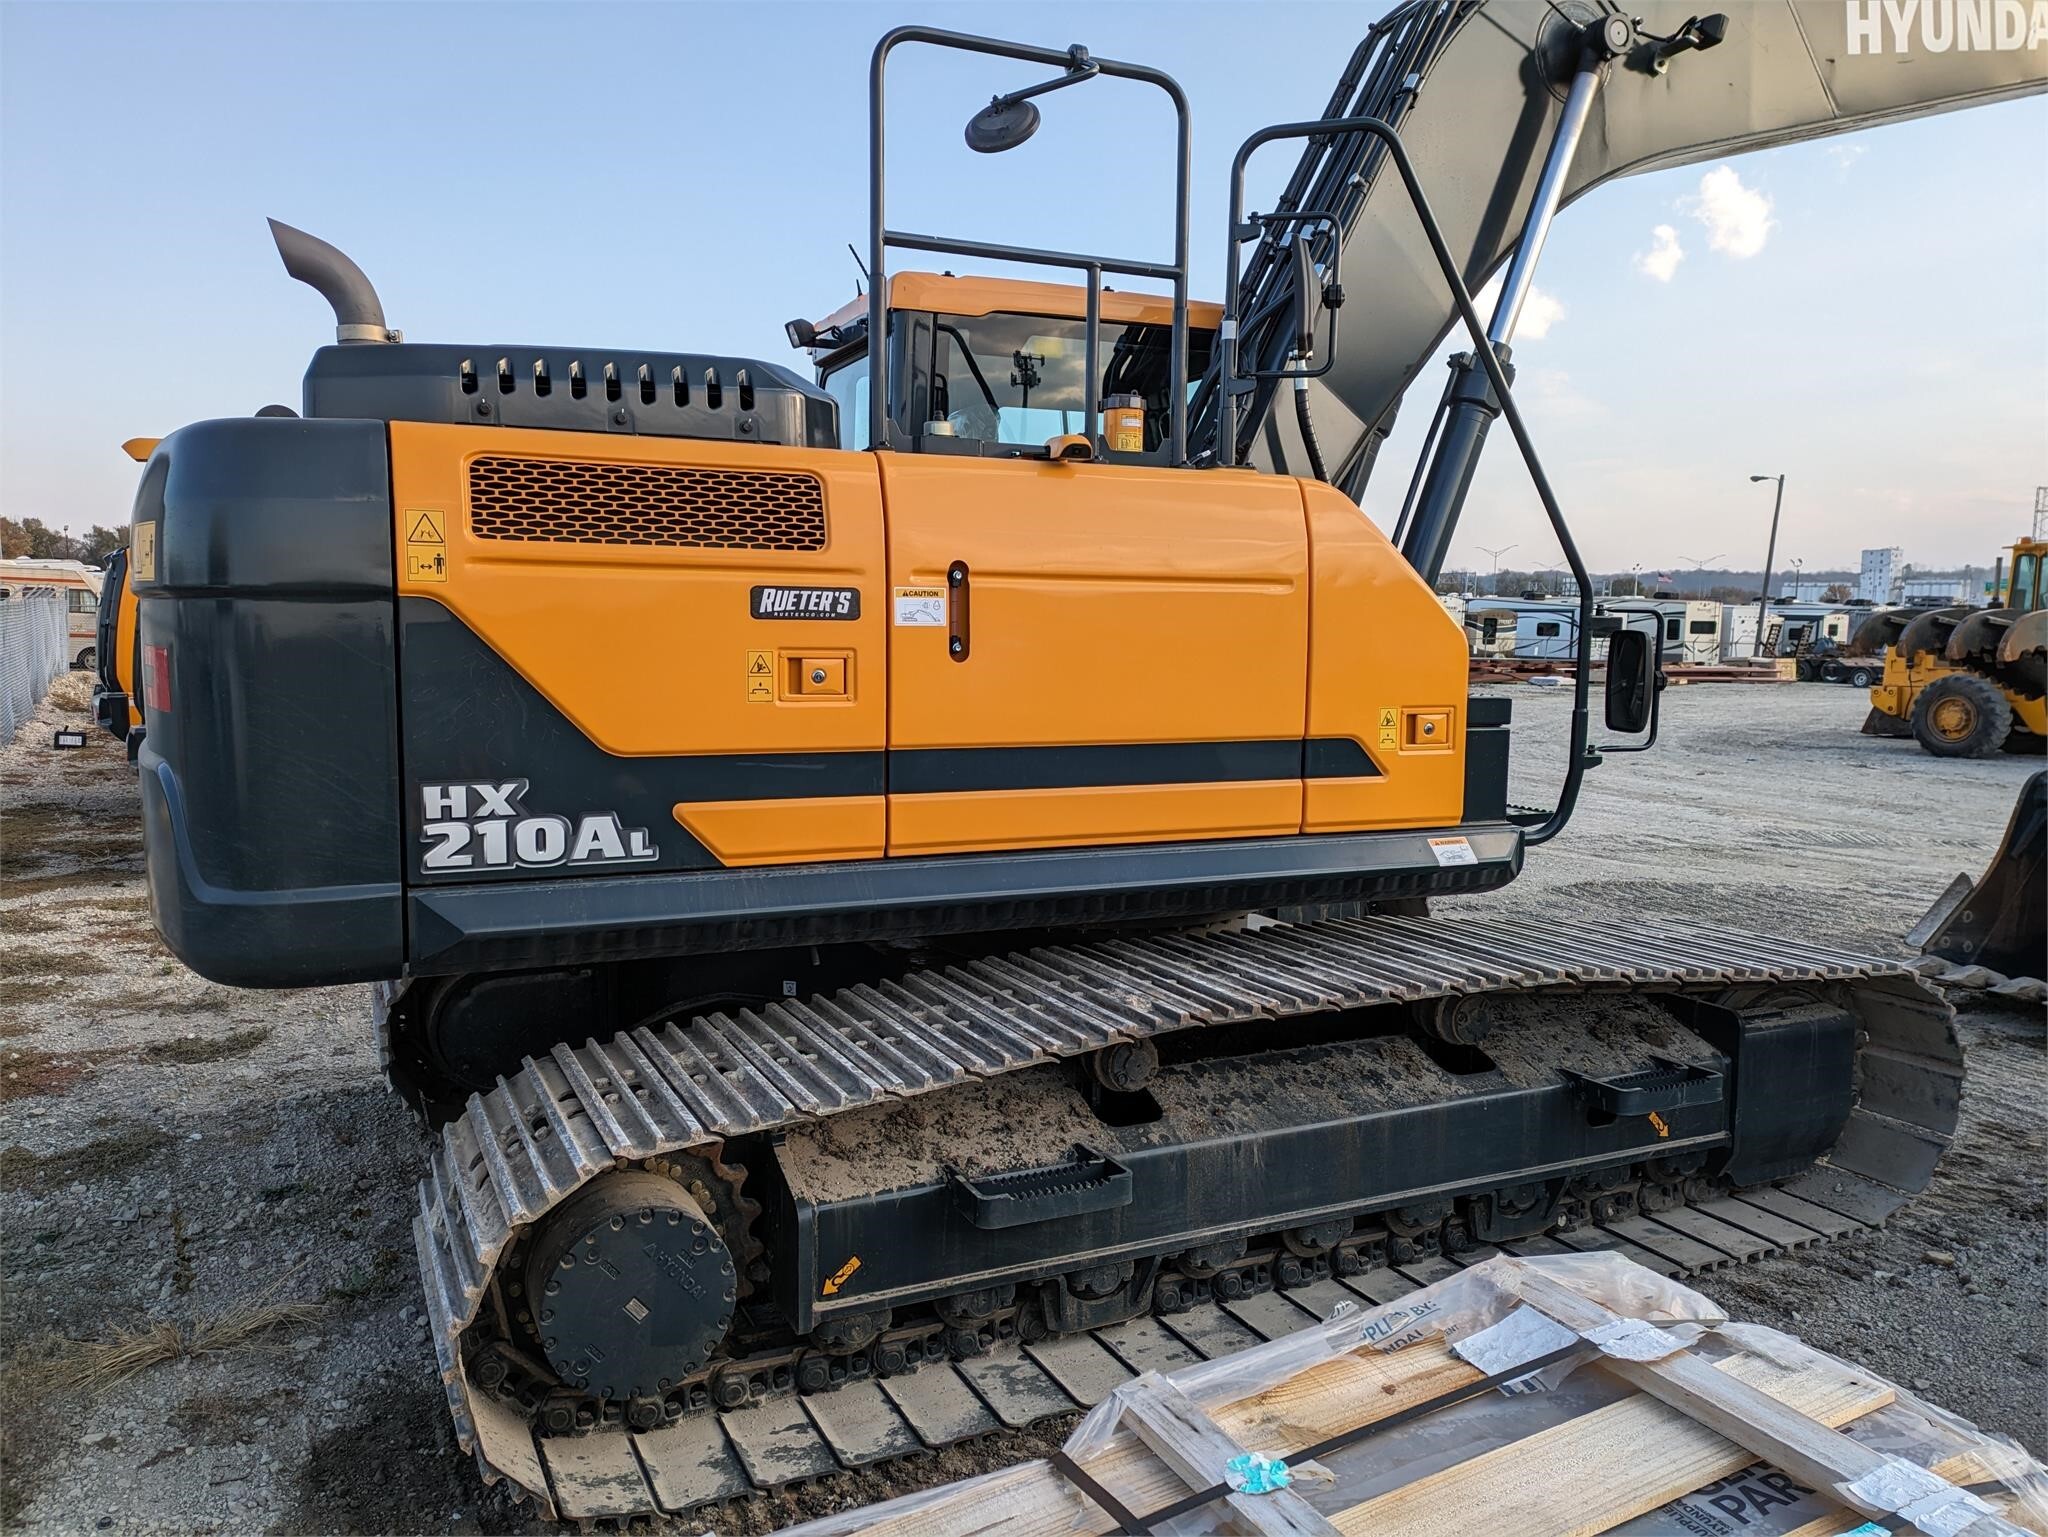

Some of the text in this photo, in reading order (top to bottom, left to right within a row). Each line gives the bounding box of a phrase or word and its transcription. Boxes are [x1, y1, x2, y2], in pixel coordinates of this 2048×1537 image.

[759, 588, 852, 614] RUETER'S
[423, 783, 519, 819] HX
[1409, 1300, 1437, 1316] BY:
[1662, 1505, 1713, 1537] UPPLIE
